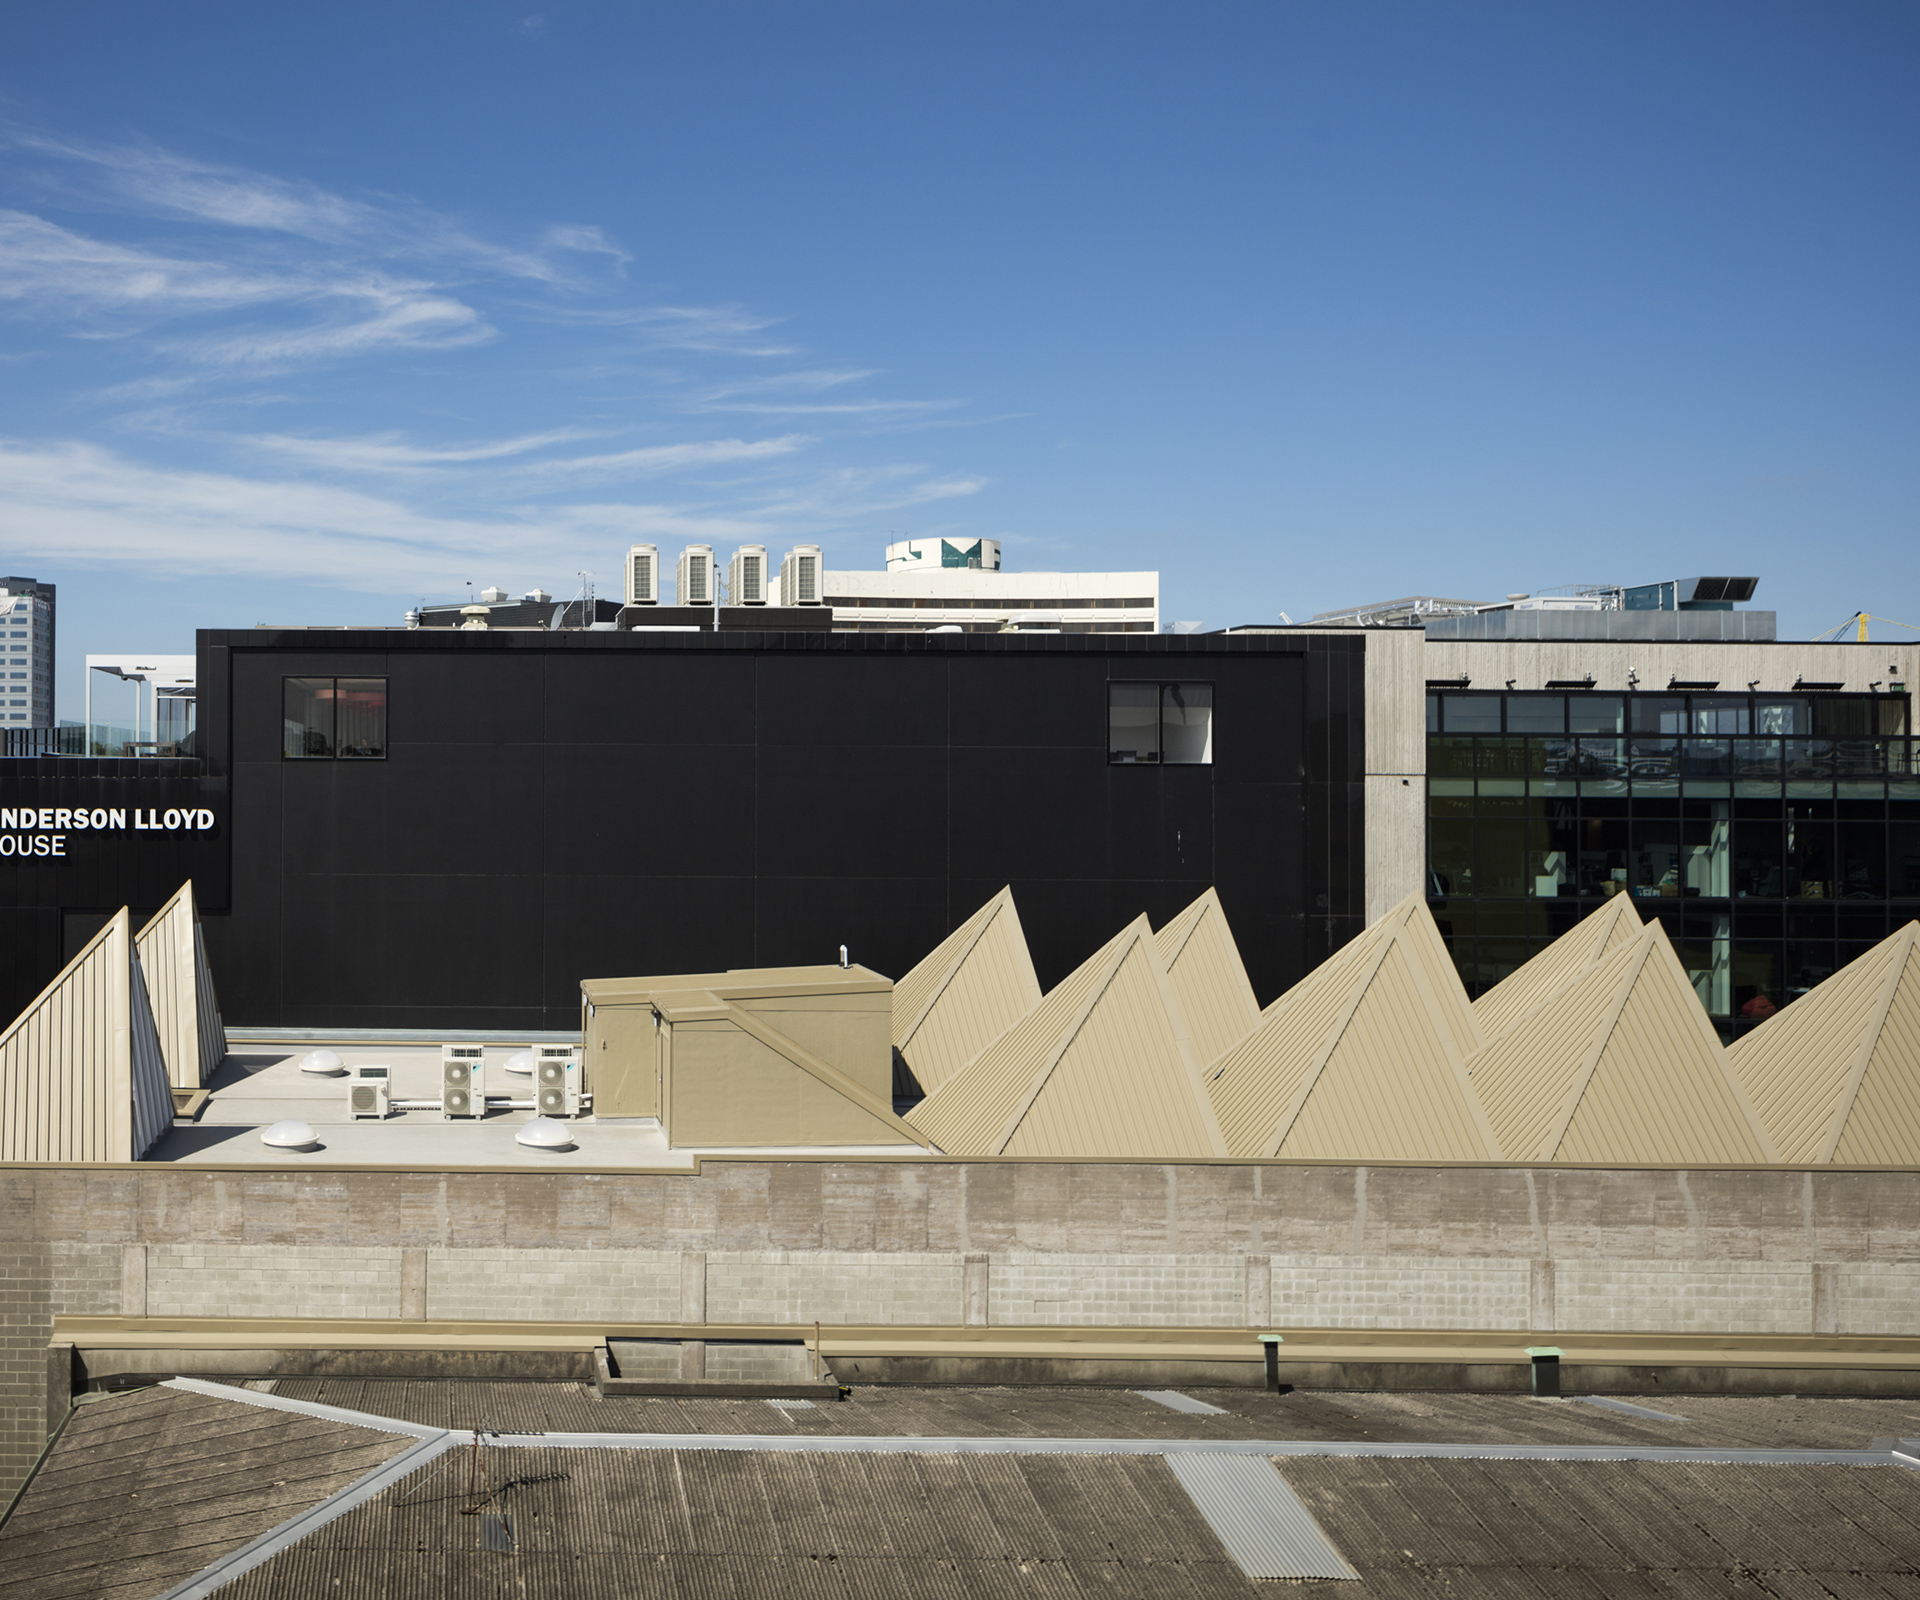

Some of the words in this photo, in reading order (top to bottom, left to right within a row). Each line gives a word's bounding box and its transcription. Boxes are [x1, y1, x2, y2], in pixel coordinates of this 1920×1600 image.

[1, 808, 126, 829] NDERSON
[134, 808, 215, 830] LLOYD
[0, 834, 67, 856] OUSE
